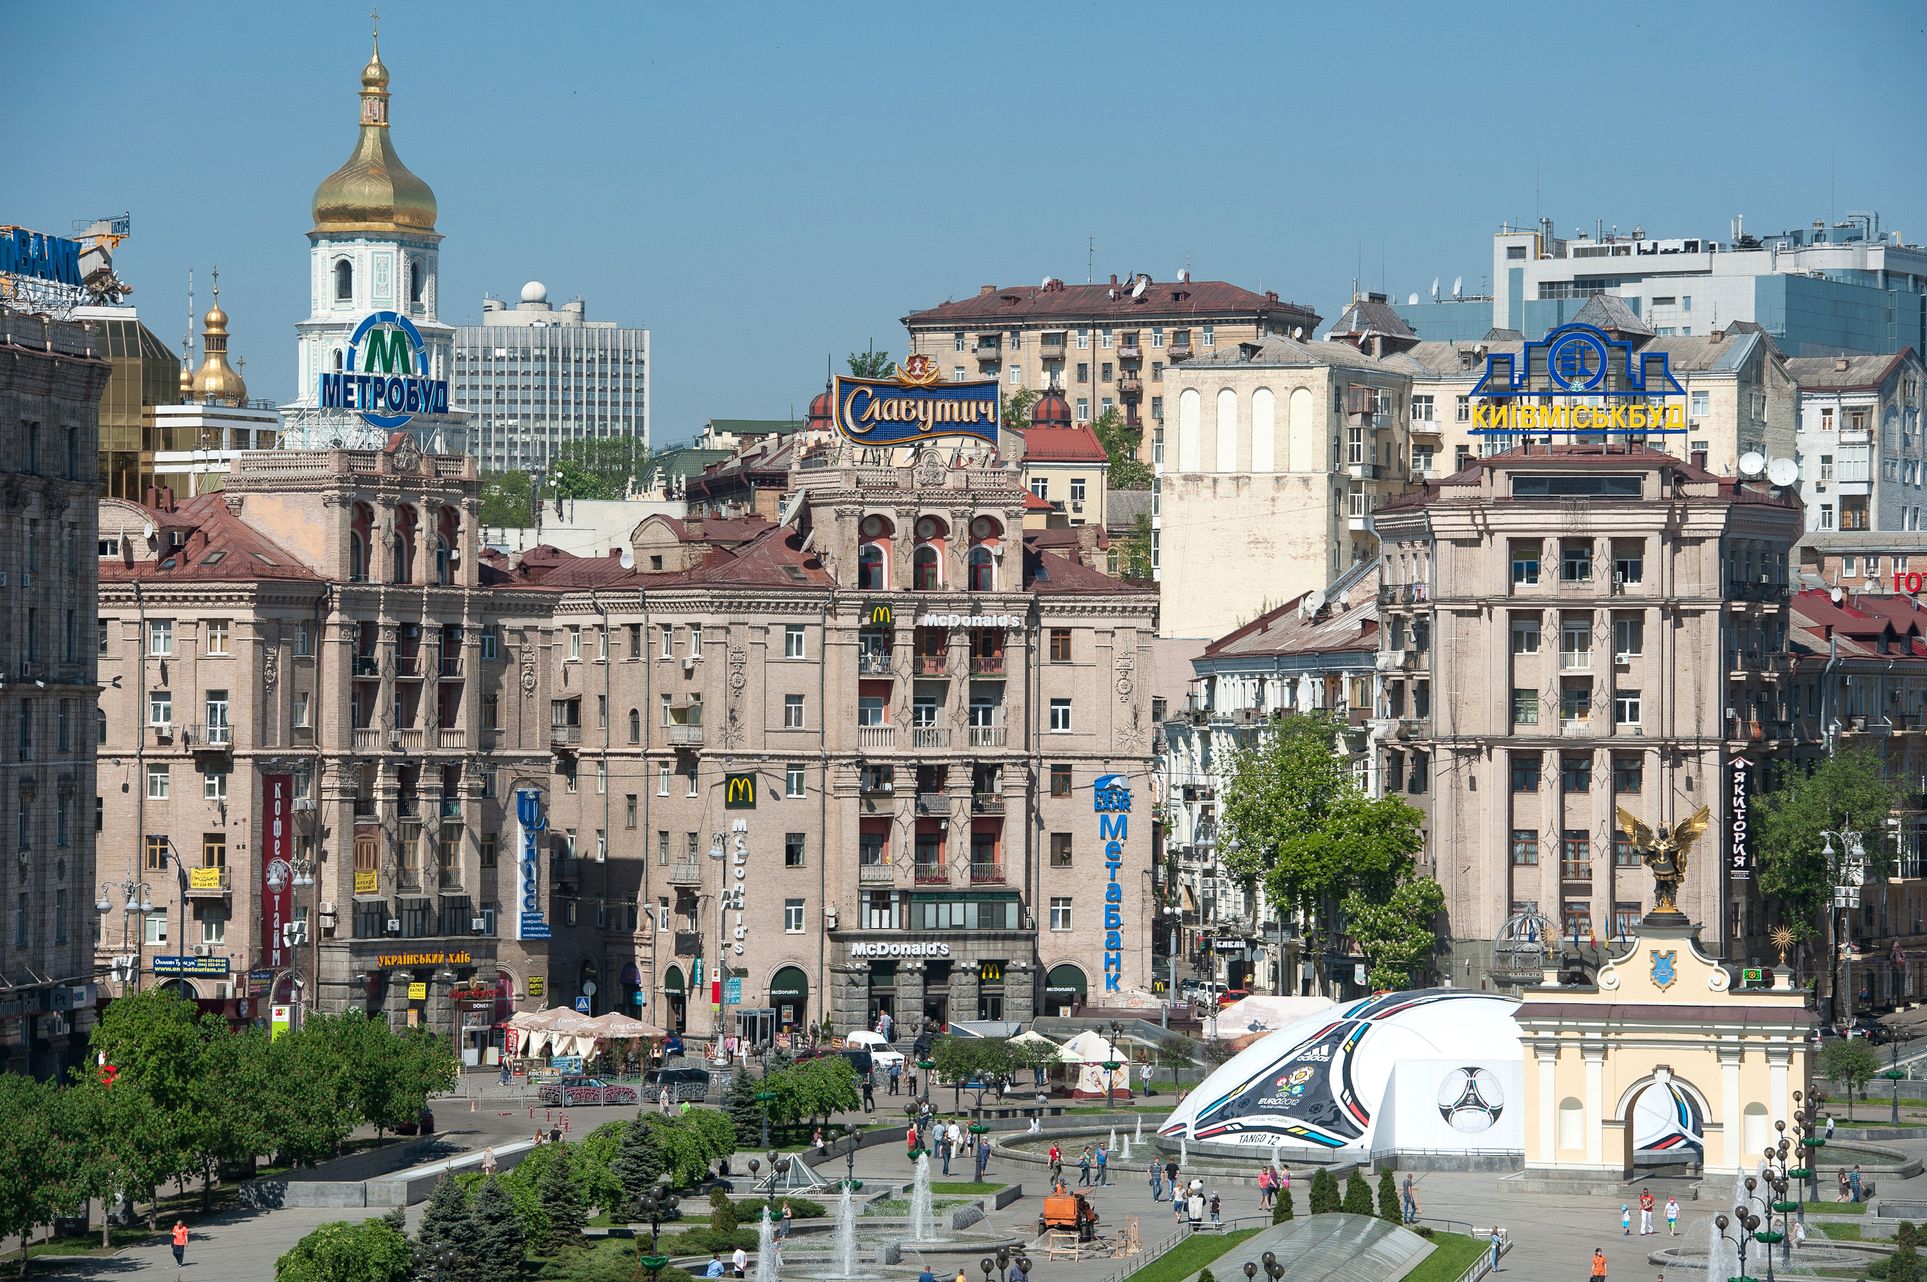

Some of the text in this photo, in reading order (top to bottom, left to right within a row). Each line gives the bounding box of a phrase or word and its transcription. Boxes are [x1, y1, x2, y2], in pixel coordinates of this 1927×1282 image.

[319, 373, 448, 414] МЕТРОБУД
[844, 386, 997, 432] Славутич
[1472, 401, 1685, 429] КИЇВМІСЬКБУД
[923, 614, 1020, 627] McDonald's
[1733, 771, 1747, 868] ЯКИТОРИЯ
[1099, 814, 1127, 991] МетаБанк
[377, 951, 445, 968] УКРАЇНСЬКИЙ
[852, 942, 950, 956] McDonald's
[1297, 1054, 1331, 1063] adidas
[1239, 1133, 1281, 1146] TANGO 12
